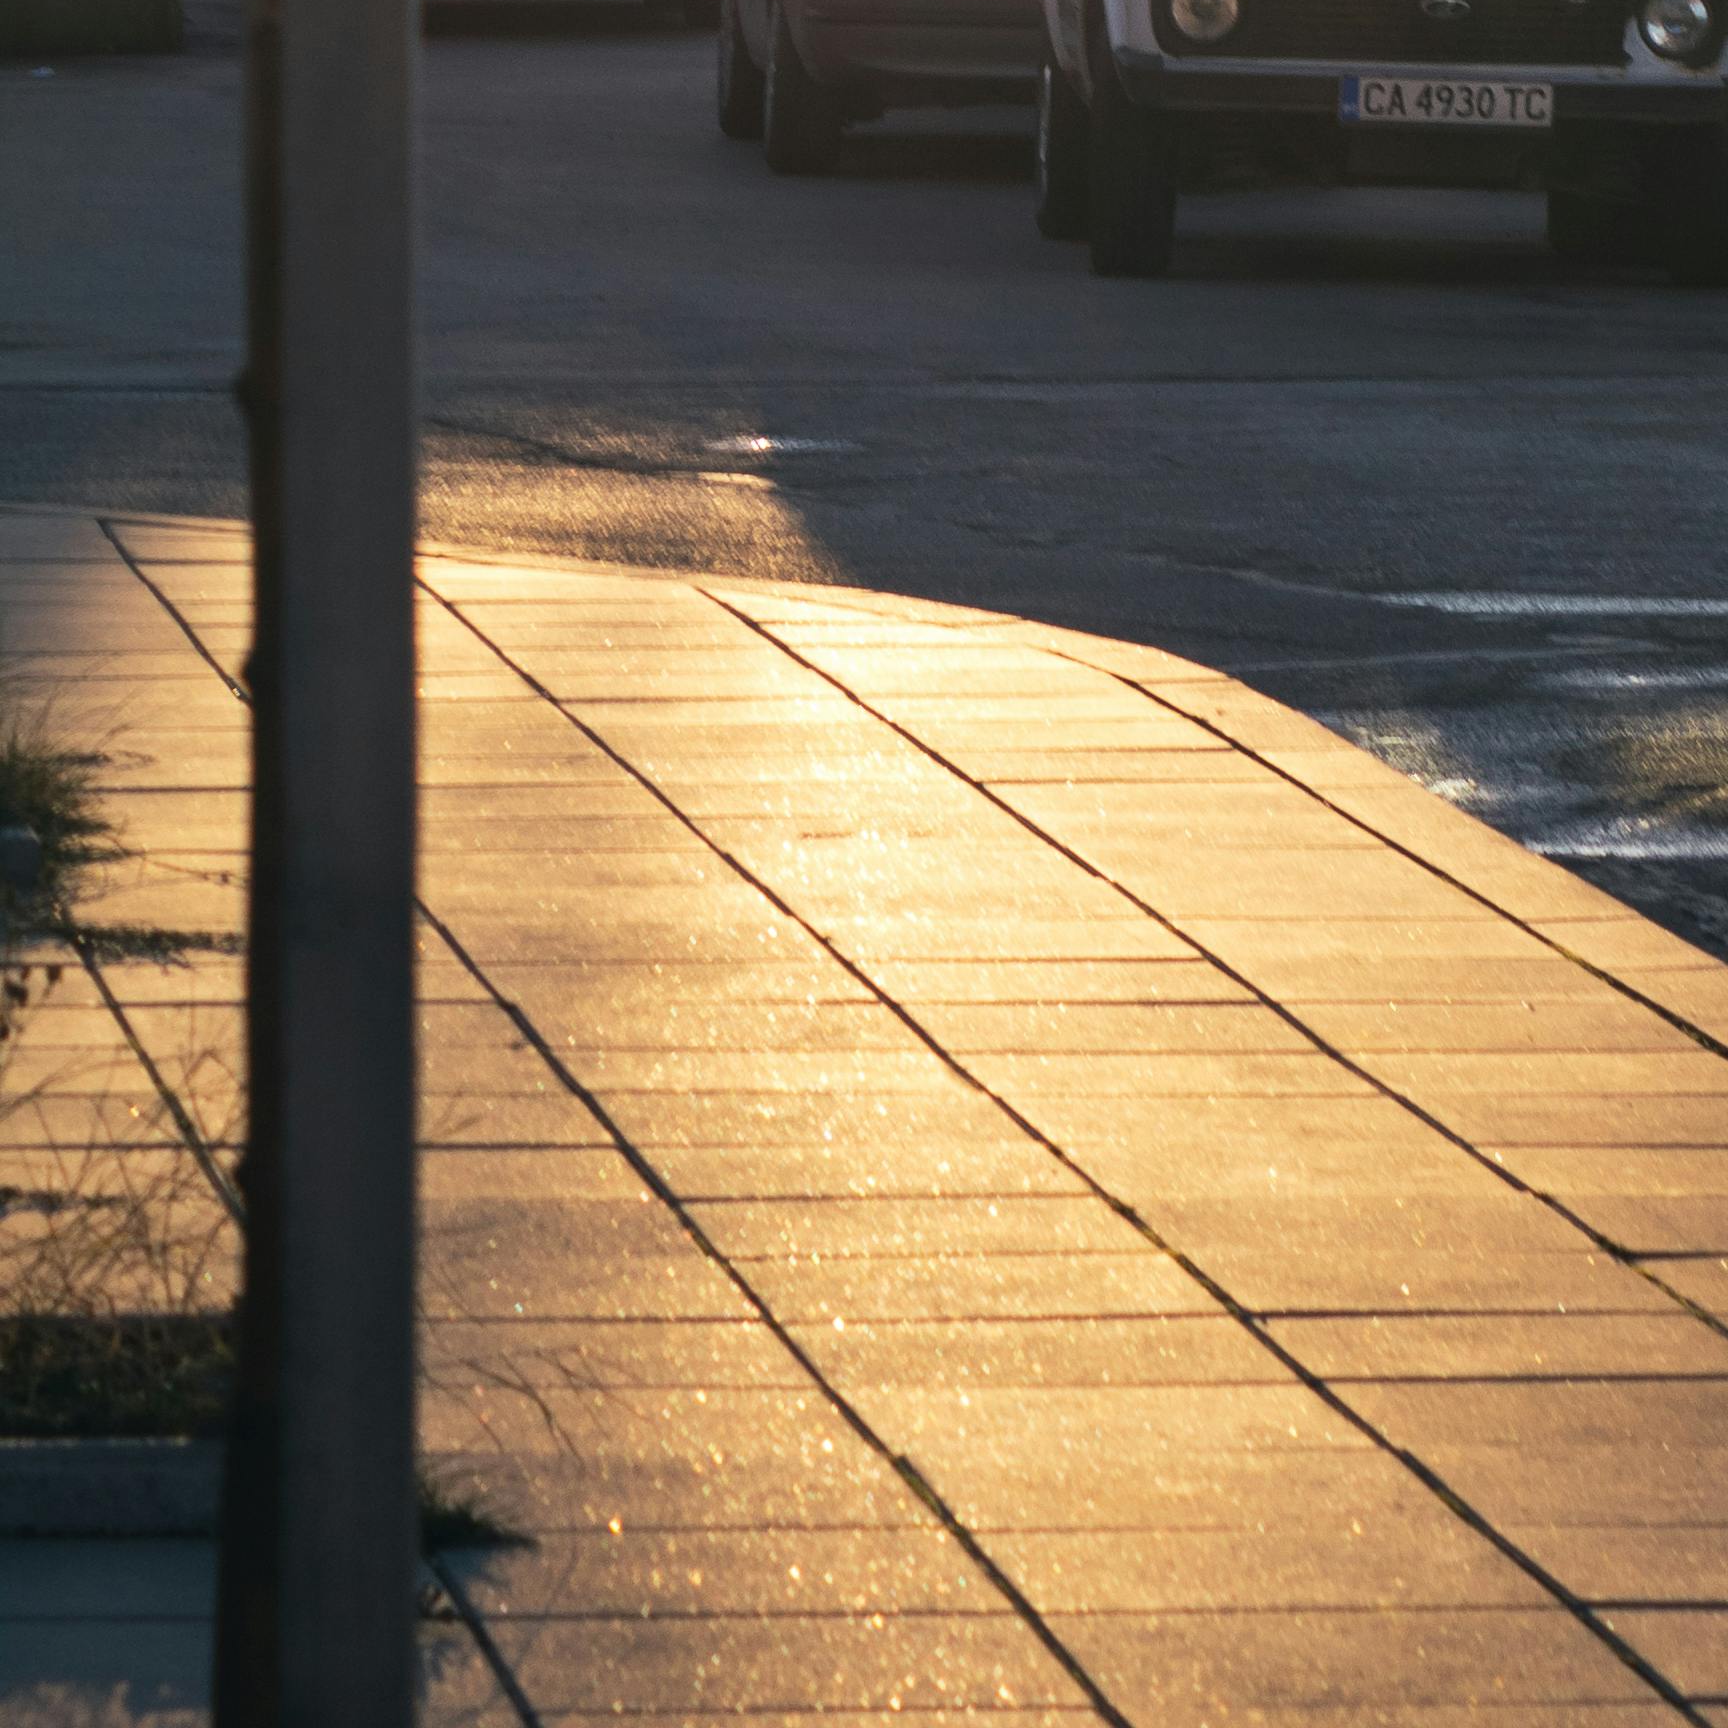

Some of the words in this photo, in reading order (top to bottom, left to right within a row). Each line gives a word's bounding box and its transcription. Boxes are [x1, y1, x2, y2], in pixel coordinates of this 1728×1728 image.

[1363, 82, 1407, 116] CA
[1415, 84, 1496, 119] 4930
[1503, 86, 1546, 120] TC
